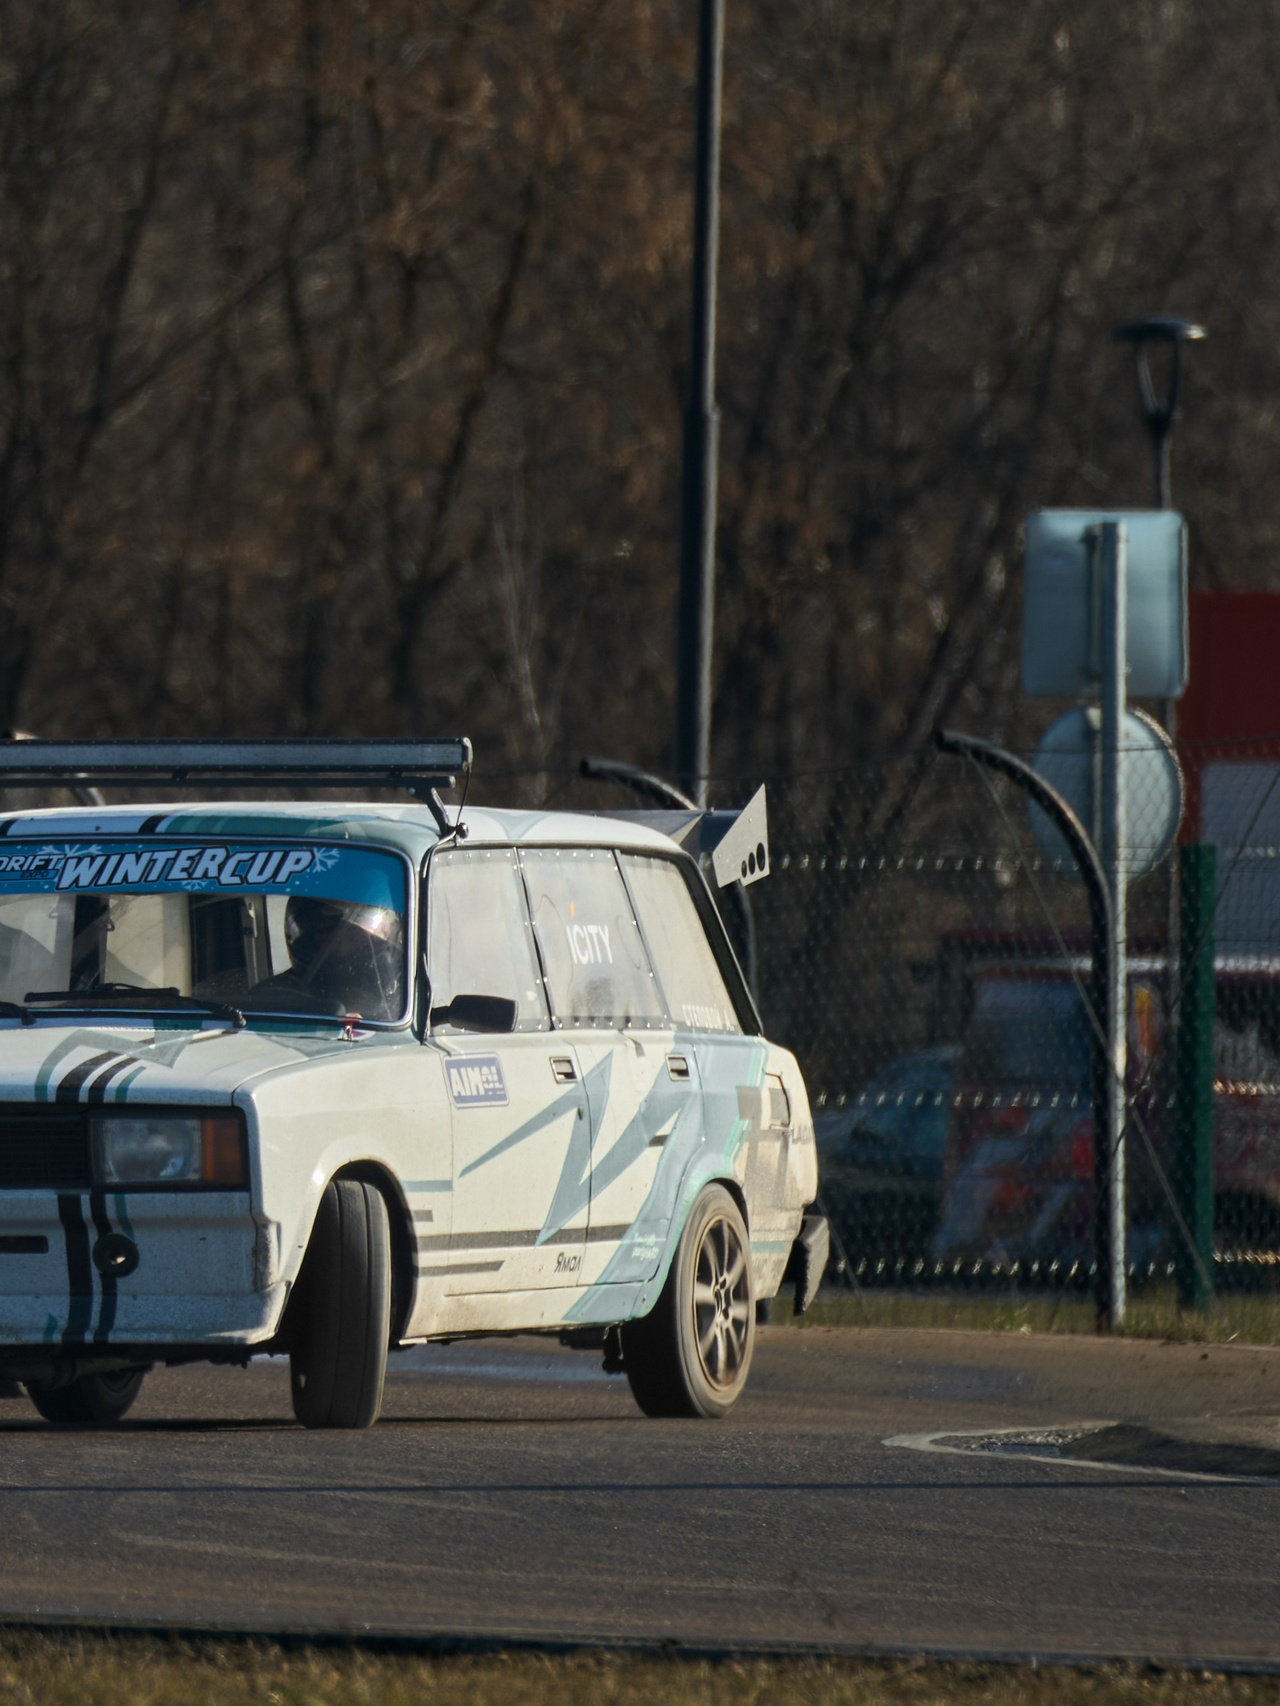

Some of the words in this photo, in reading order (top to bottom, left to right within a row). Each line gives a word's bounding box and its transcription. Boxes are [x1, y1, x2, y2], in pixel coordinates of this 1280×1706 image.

[19, 869, 51, 879] EXPO
[449, 1065, 504, 1097] AIMOL
[553, 1251, 582, 1273] Ямал
